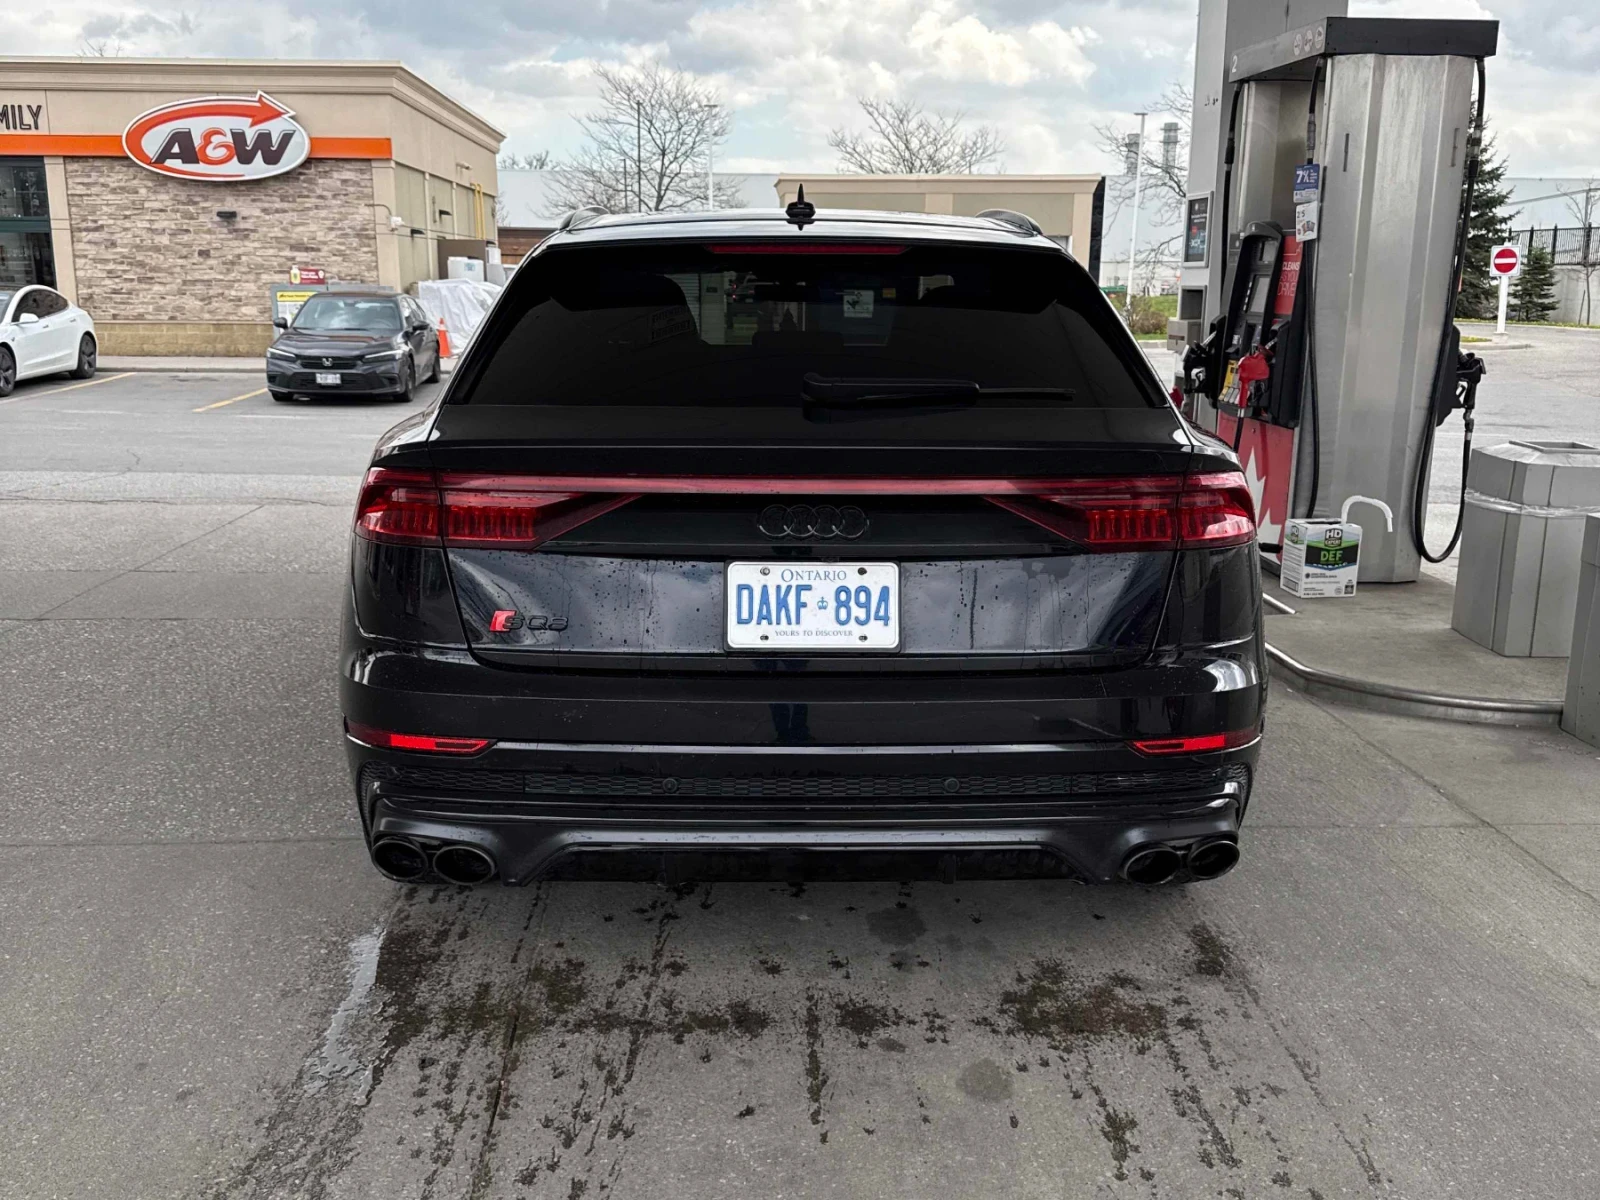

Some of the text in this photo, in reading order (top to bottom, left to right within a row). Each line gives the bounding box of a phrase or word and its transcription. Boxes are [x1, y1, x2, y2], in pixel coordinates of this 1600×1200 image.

[1231, 54, 1238, 73] 2
[150, 127, 296, 166] A&W
[1282, 261, 1300, 271] CLEANS
[1277, 282, 1296, 296] DRIVE
[1325, 529, 1342, 539] HD
[1320, 550, 1343, 561] DEF
[781, 568, 847, 582] ONTARIO
[736, 584, 890, 626] DAKF 894
[502, 614, 569, 632] SQ8
[775, 629, 853, 637] YOURS TO DISCOVER
